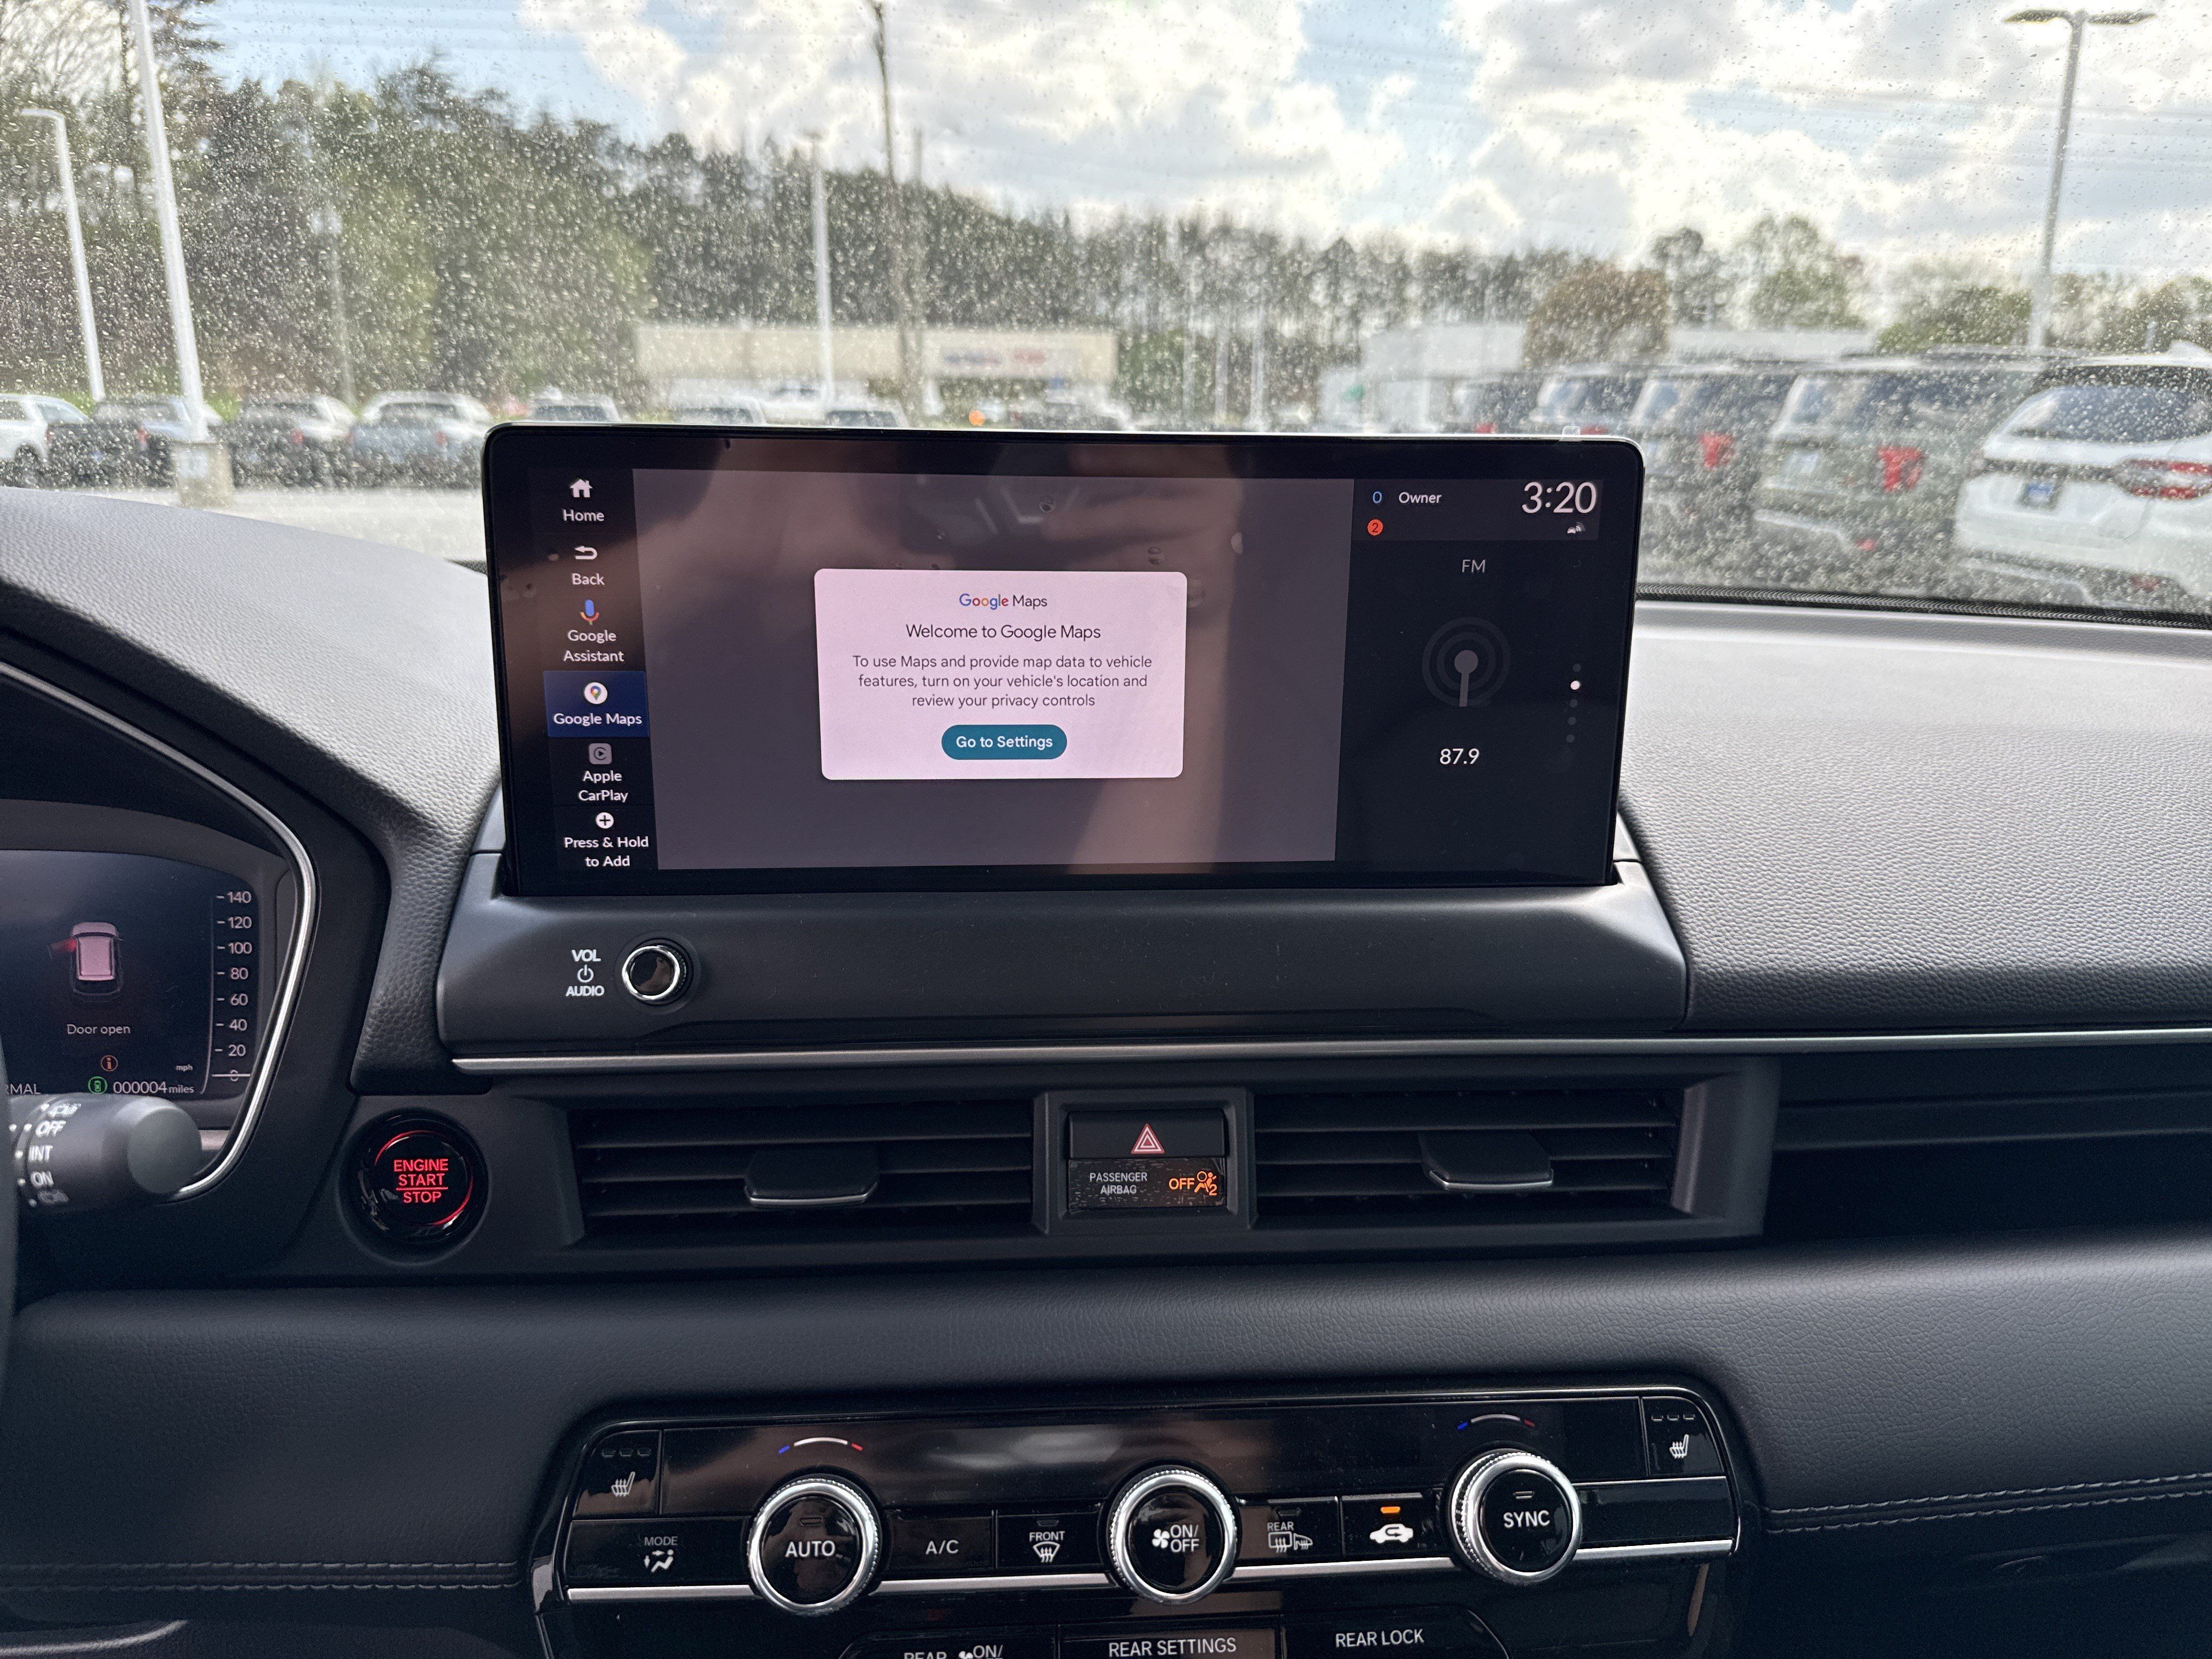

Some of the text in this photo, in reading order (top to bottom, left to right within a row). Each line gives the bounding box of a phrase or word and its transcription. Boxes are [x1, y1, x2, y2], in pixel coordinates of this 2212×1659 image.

[1399, 492, 1442, 503] Owner
[1522, 482, 1596, 513] 3:20
[563, 509, 604, 521] Home
[1372, 523, 1379, 533] 2
[1462, 560, 1485, 572] FM
[572, 573, 605, 585] Back
[959, 594, 1047, 610] Google Maps
[568, 630, 616, 644] Google
[906, 624, 1101, 641] Welcome to Google Maps
[563, 650, 624, 662] Assistant
[853, 655, 1152, 670] To use Maps and provide map data to vehicle
[859, 674, 1147, 690] features, turn on your vehicle's location and
[913, 694, 1094, 709] review your privacy controls
[554, 713, 642, 726] Google Maps
[956, 735, 1053, 750] Go to Settings
[1440, 748, 1479, 764] 87.9
[583, 770, 622, 783] Apple
[579, 789, 628, 803] CarPlay
[565, 836, 648, 848] Press & Hold
[585, 855, 630, 867] to Add
[228, 891, 251, 903] 140
[228, 916, 252, 928] 120
[228, 942, 252, 954] 100
[572, 949, 601, 962] VOL
[230, 968, 248, 980] 80
[566, 985, 605, 996] AUDIO
[230, 994, 248, 1006] 60
[67, 1024, 131, 1036] Door open
[229, 1019, 247, 1031] 40
[228, 1045, 246, 1056] 20
[113, 1081, 194, 1093] 000004 miles
[36, 1120, 66, 1137] OFF
[29, 1144, 53, 1161] INT
[394, 1159, 448, 1171] ENGINE
[31, 1171, 54, 1187] ON
[399, 1173, 444, 1186] START
[1090, 1172, 1147, 1182] PASSENGER
[1169, 1178, 1195, 1189] OFF
[1101, 1185, 1137, 1195] AIRBAG
[403, 1192, 441, 1203] STOP
[1504, 1510, 1550, 1528] SYNC
[1170, 1525, 1199, 1538] ON/
[1267, 1521, 1294, 1531] REAR
[645, 1536, 678, 1546] MODE
[1029, 1531, 1065, 1542] FRONT
[786, 1541, 835, 1557] AUTO
[926, 1540, 958, 1554] A/C
[1171, 1538, 1199, 1552] OFF
[1336, 1629, 1424, 1647] REAR LOCK
[973, 1645, 1003, 1659] ON/
[1109, 1638, 1236, 1657] REAR SETTINGS
